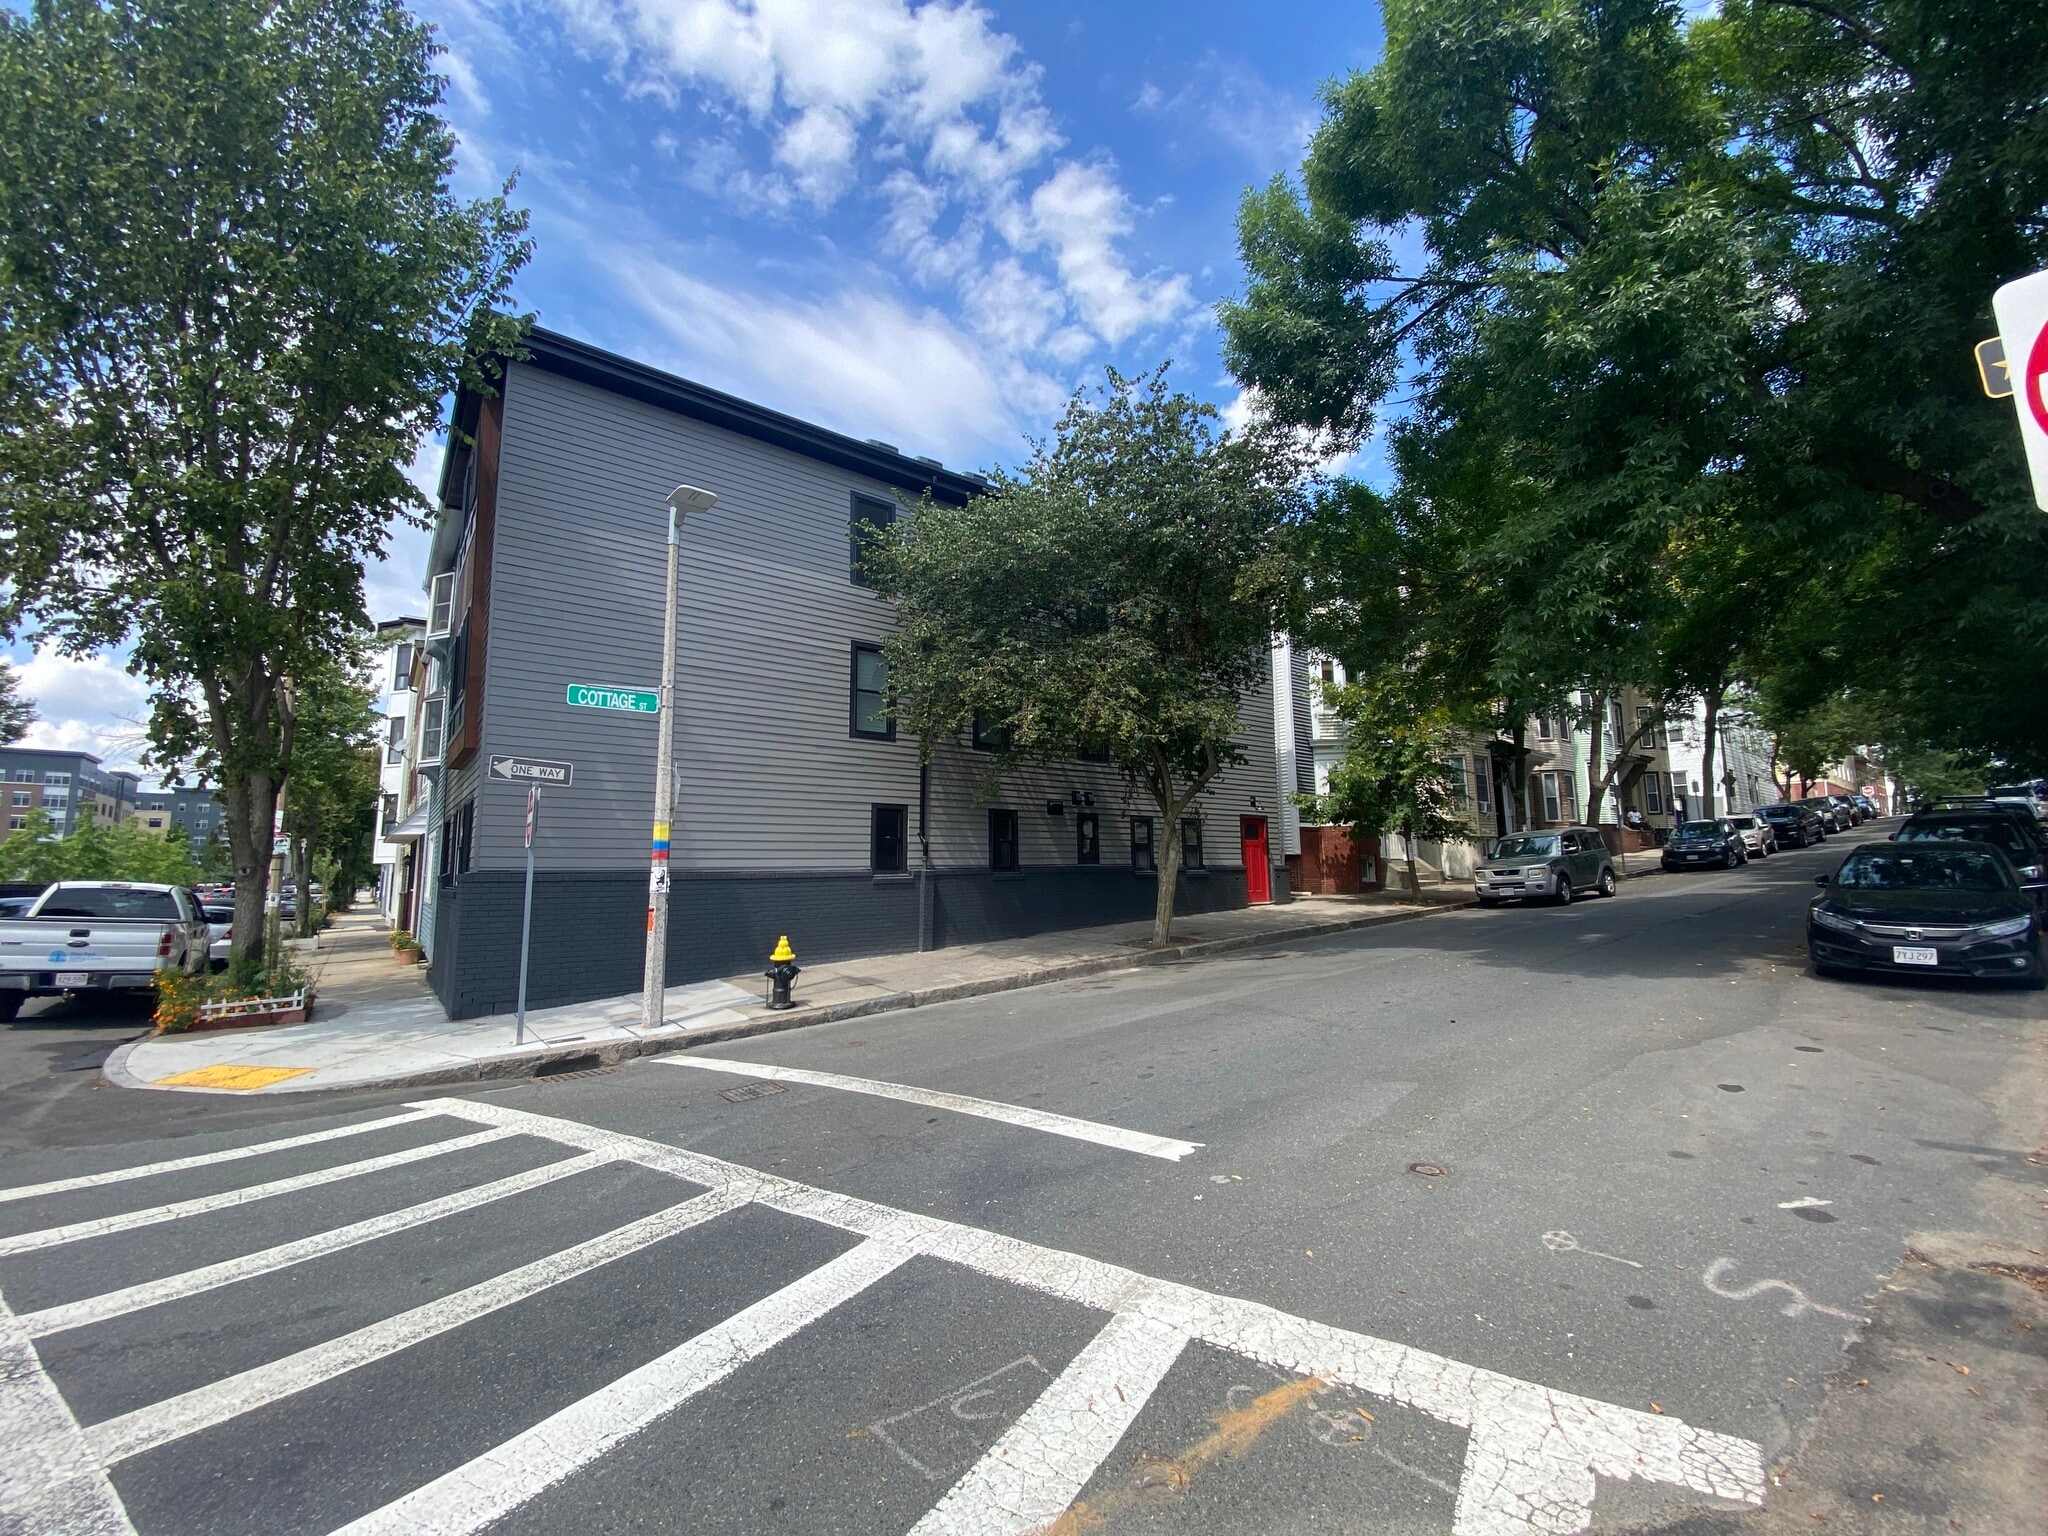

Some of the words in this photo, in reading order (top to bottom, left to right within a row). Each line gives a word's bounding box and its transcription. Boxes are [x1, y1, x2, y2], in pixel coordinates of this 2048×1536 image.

[578, 689, 636, 709] COTTAGE
[639, 702, 648, 711] ST
[511, 765, 533, 775] ONE
[539, 767, 562, 778] WAY
[1916, 952, 1934, 961] 297
